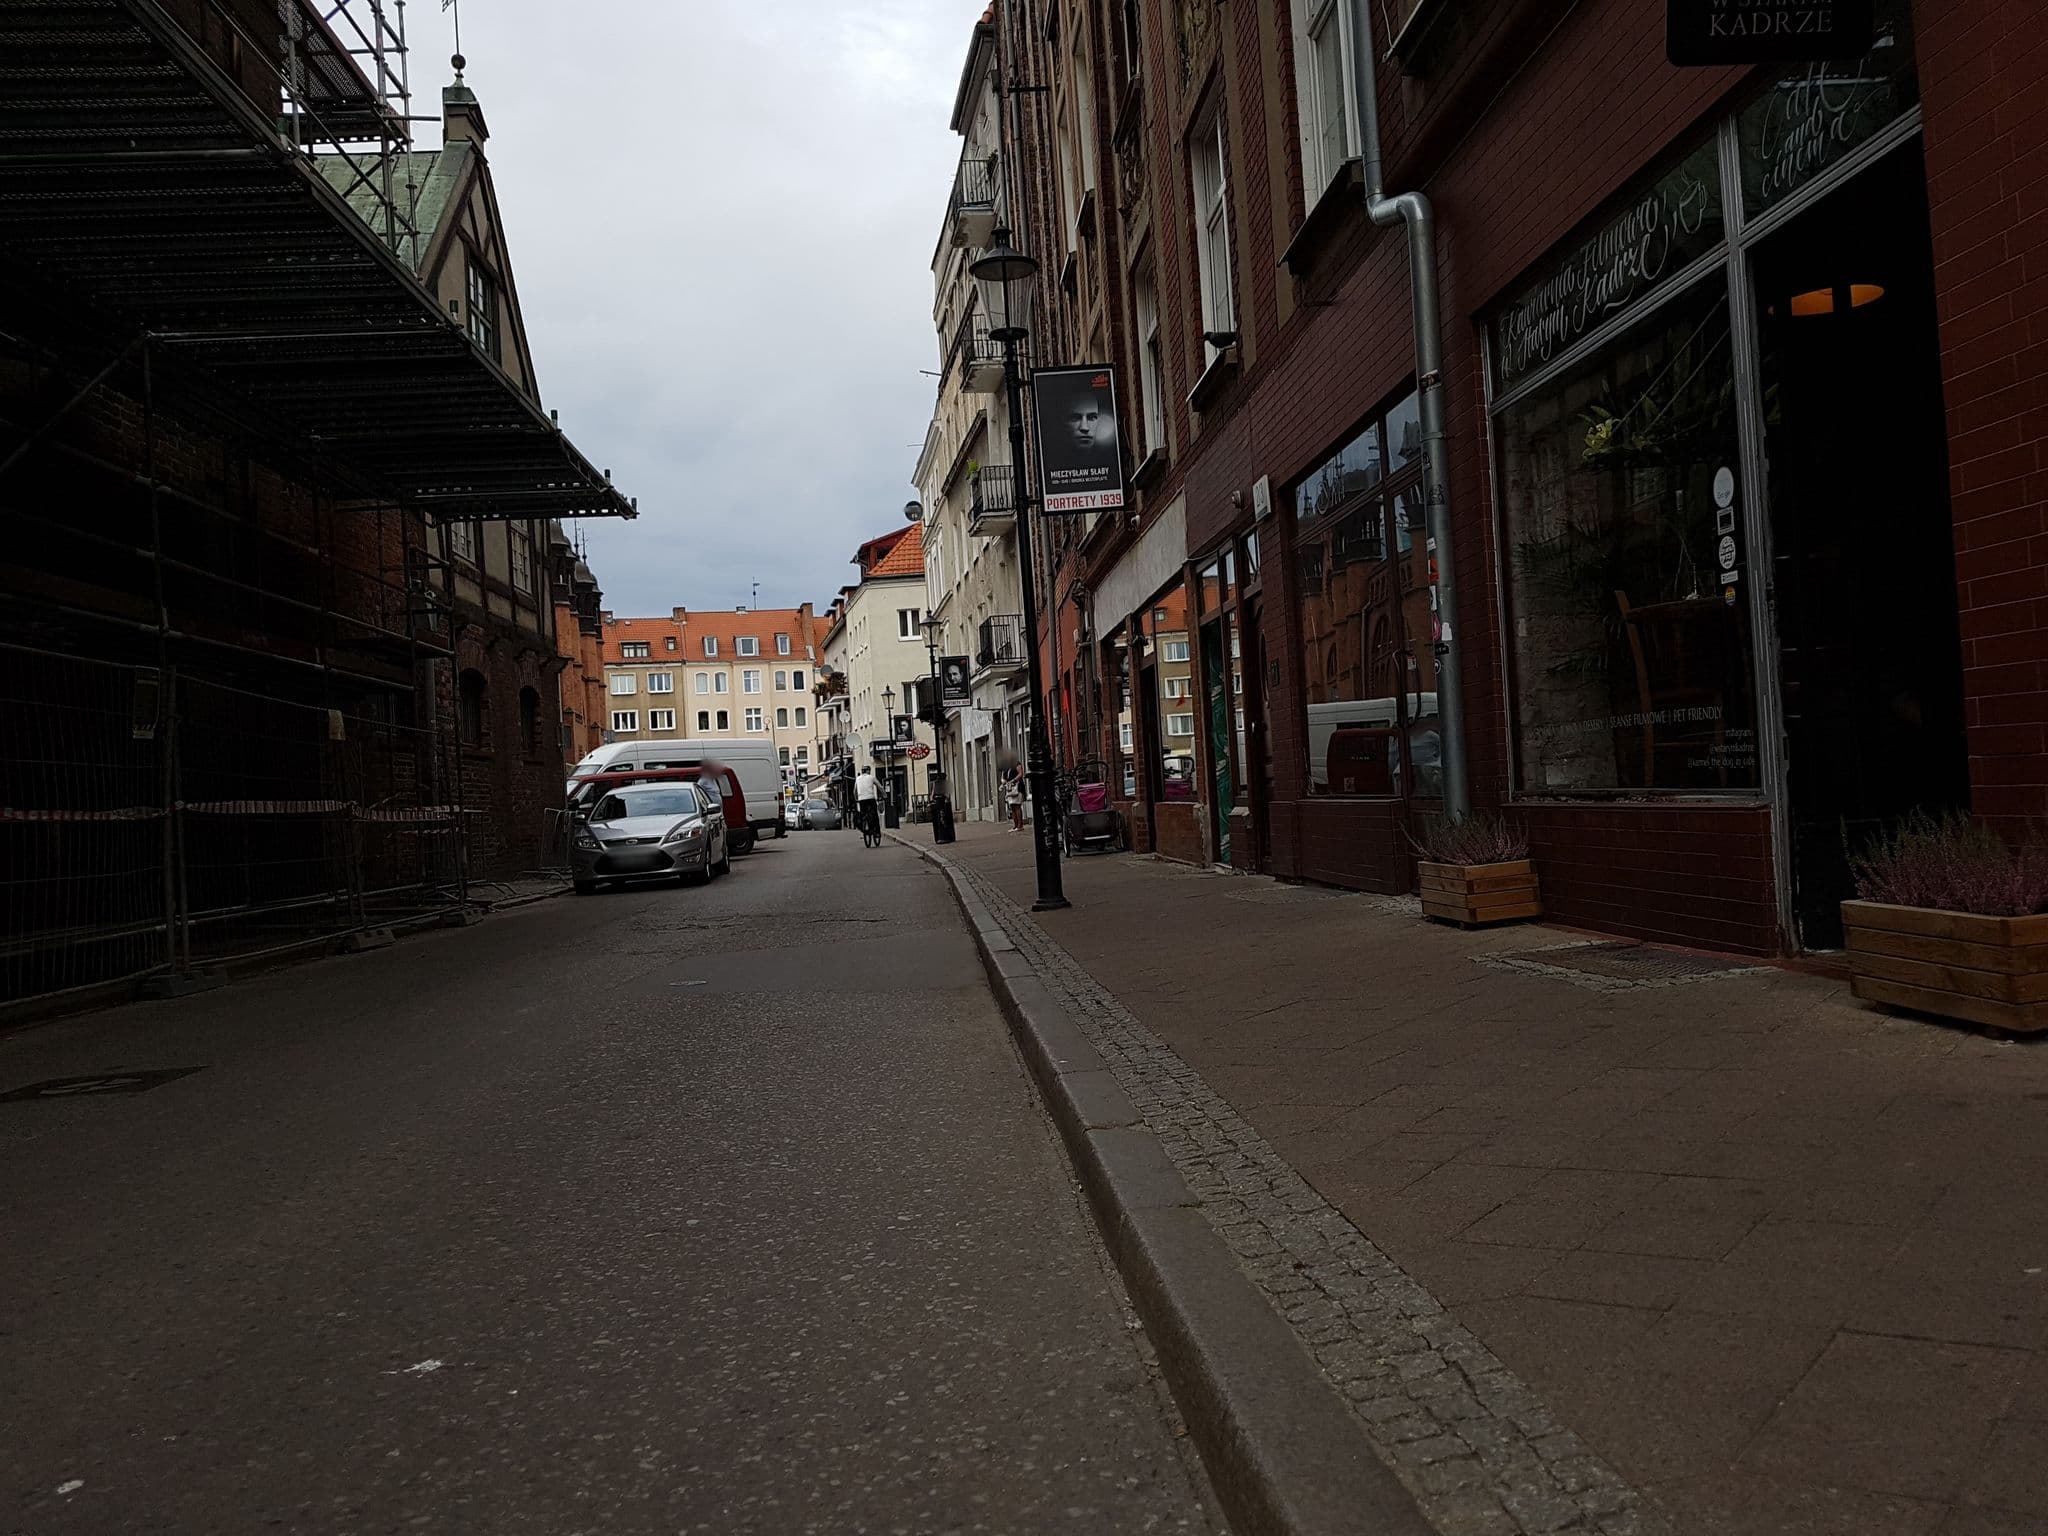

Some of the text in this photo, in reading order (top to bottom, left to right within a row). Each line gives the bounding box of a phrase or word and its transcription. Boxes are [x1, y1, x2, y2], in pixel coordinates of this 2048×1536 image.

[1710, 10, 1833, 36] KADRZE
[1047, 493, 1122, 509] PORTRETY 1939
[1687, 705, 1722, 721] FRIENDLY
